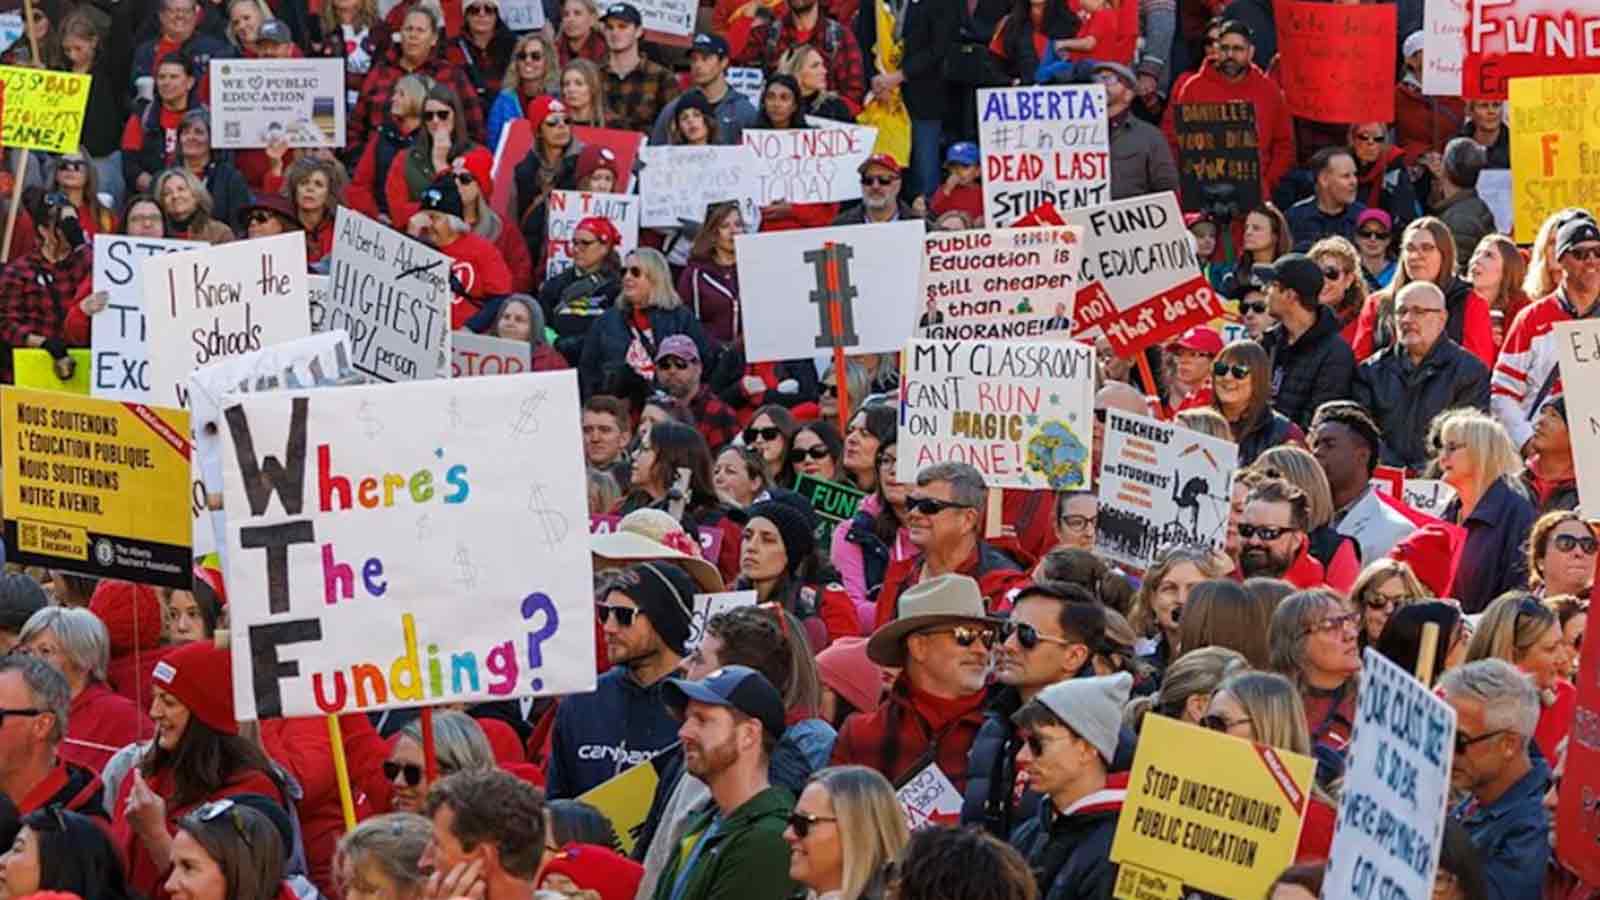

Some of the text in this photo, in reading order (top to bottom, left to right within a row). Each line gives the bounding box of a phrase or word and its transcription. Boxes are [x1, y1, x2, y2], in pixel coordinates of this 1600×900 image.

[222, 78, 319, 89] WE PUBLIC
[222, 91, 305, 103] EDUCATION
[983, 90, 1104, 121] ALBERTA:
[745, 133, 782, 159] NO
[790, 128, 863, 160] INSIDE
[1541, 133, 1561, 177] F
[987, 152, 1108, 182] DEAD LAST
[1089, 203, 1168, 238] FUND
[340, 217, 385, 261] Alberta
[928, 247, 1071, 272] Education is
[1100, 237, 1199, 280] EDUCATION
[193, 262, 242, 308] Knew
[257, 253, 292, 296] the
[926, 277, 973, 299] still
[332, 259, 440, 350] HIGHEST
[948, 297, 1004, 318] than
[1079, 286, 1214, 345] not that deep
[913, 343, 1093, 380] MY CLASSROOM
[978, 382, 1041, 413] RUN
[17, 402, 48, 427] NOUS
[51, 408, 119, 437] SOUTENONS
[908, 411, 1024, 442] ON MAGIC
[18, 456, 119, 490] NOUS SOUTENONS
[94, 443, 155, 470] PUBLIQUE.
[223, 396, 470, 517] Where's
[19, 485, 104, 515] NOTRE AVENIR.
[239, 519, 388, 615] The
[247, 591, 560, 719] Funding?
[1142, 764, 1283, 834] STOP UNDERFUNDING
[1132, 806, 1259, 868] PUBLIC EDUCATION
